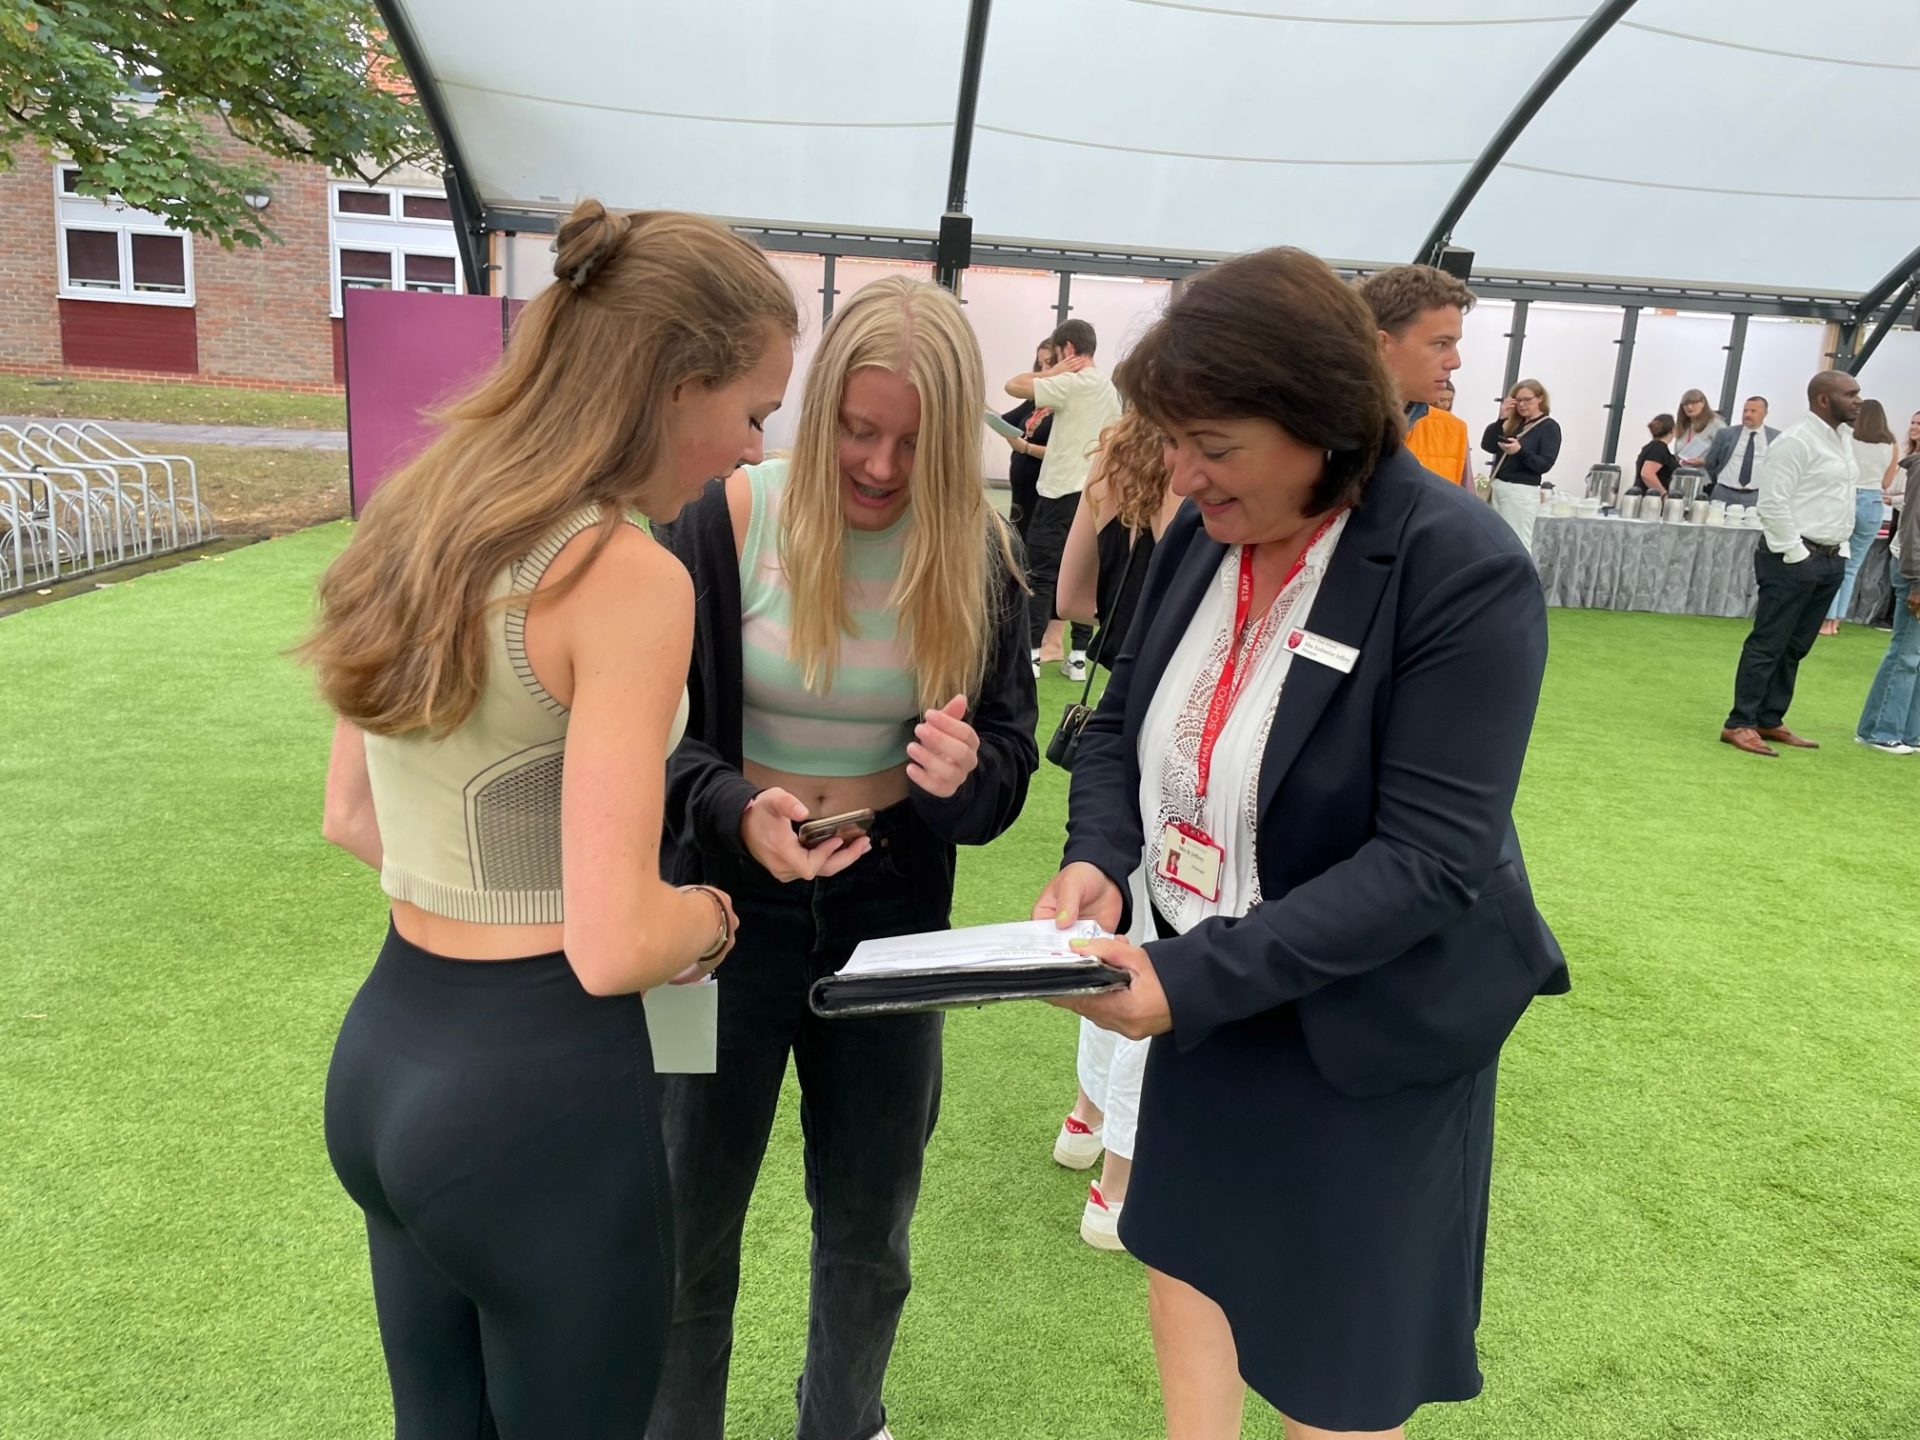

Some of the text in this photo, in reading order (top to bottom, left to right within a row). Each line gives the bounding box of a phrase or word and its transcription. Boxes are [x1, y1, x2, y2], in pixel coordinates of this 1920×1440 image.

[1241, 573, 1250, 601] STAFF
[1196, 683, 1230, 792] NEW HALL SCHOOL
